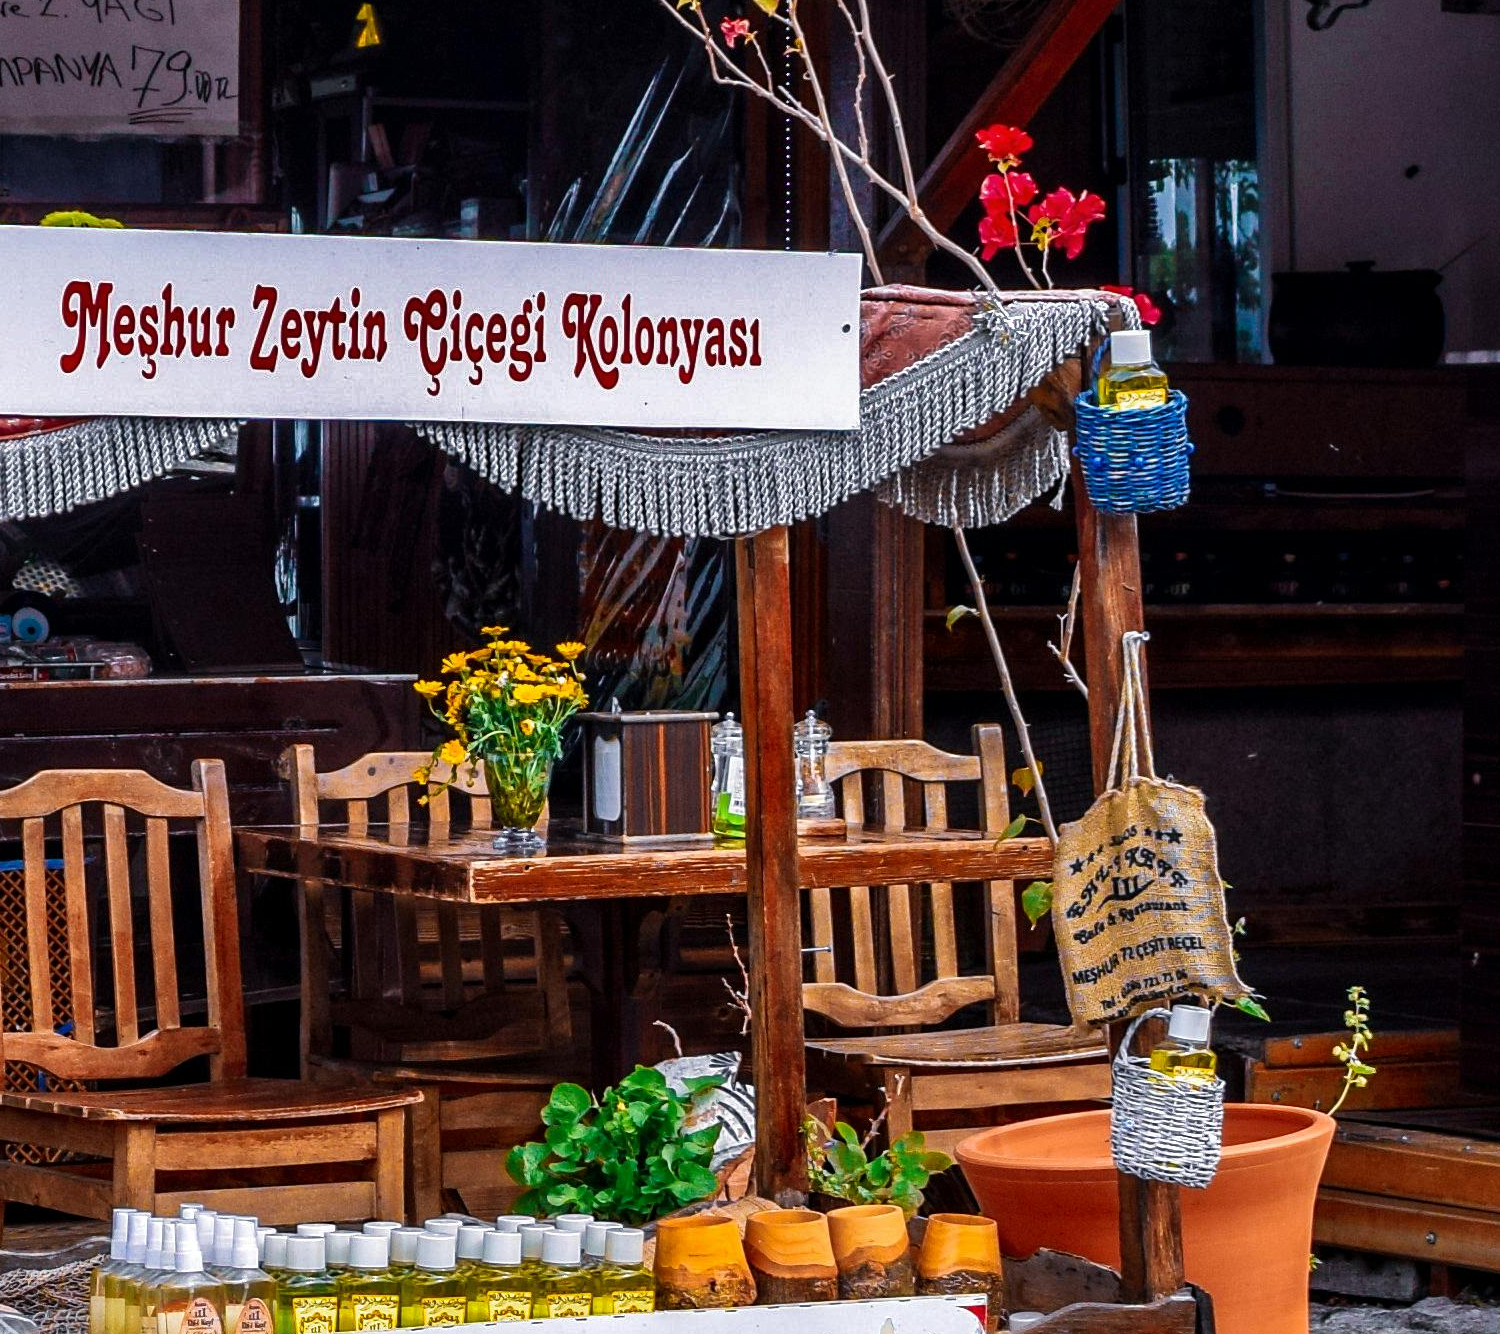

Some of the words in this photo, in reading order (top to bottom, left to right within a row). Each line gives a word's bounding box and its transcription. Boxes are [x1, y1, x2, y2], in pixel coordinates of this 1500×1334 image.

[60, 280, 236, 380] Meşhur
[249, 283, 389, 379] Zeytin
[561, 291, 763, 390] Kolonyası
[1072, 953, 1120, 985] MEŞHUR
[1119, 945, 1135, 960] 72
[1166, 936, 1206, 952] REÇEL
